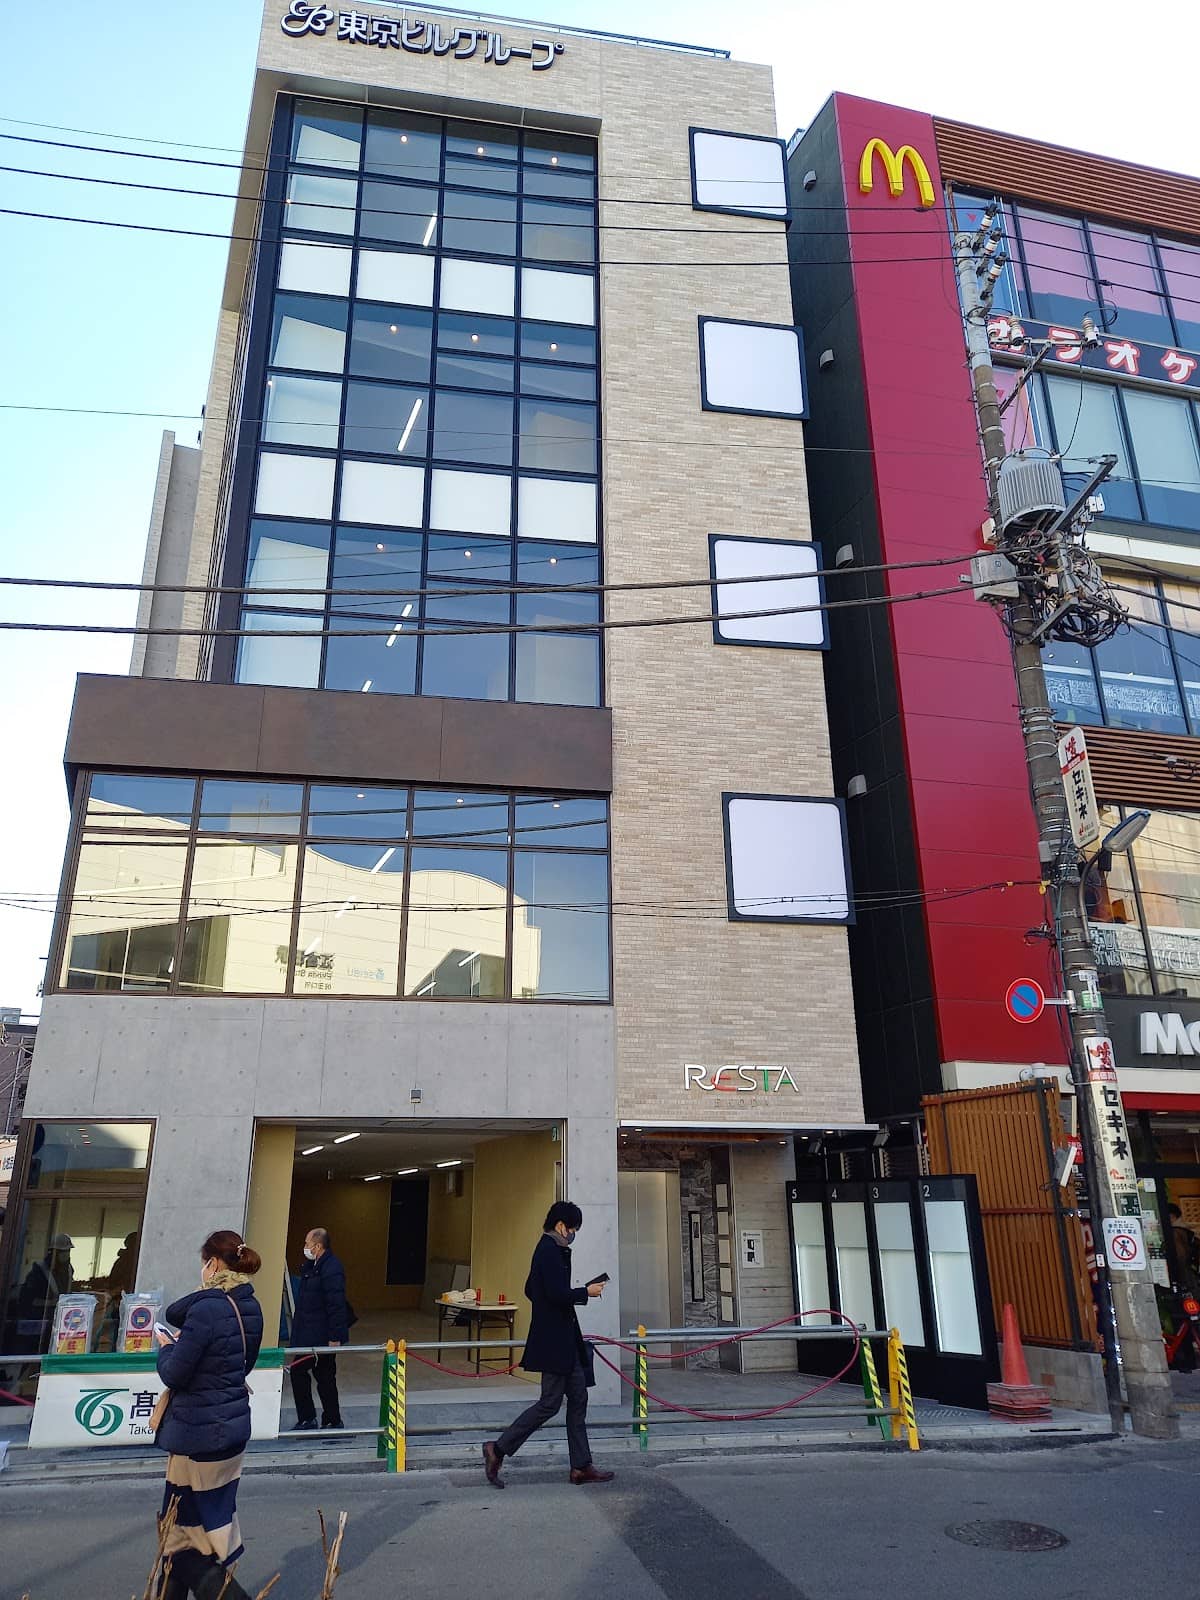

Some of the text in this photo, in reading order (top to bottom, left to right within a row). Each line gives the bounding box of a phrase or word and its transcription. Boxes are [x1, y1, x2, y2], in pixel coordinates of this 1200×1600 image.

[337, 10, 565, 71] 東京ビルグループ
[1073, 769, 1088, 819] セキネ
[684, 1063, 799, 1092] RESTA
[1100, 1085, 1130, 1160] セキネ
[791, 1184, 931, 1200] 5 4 3 2
